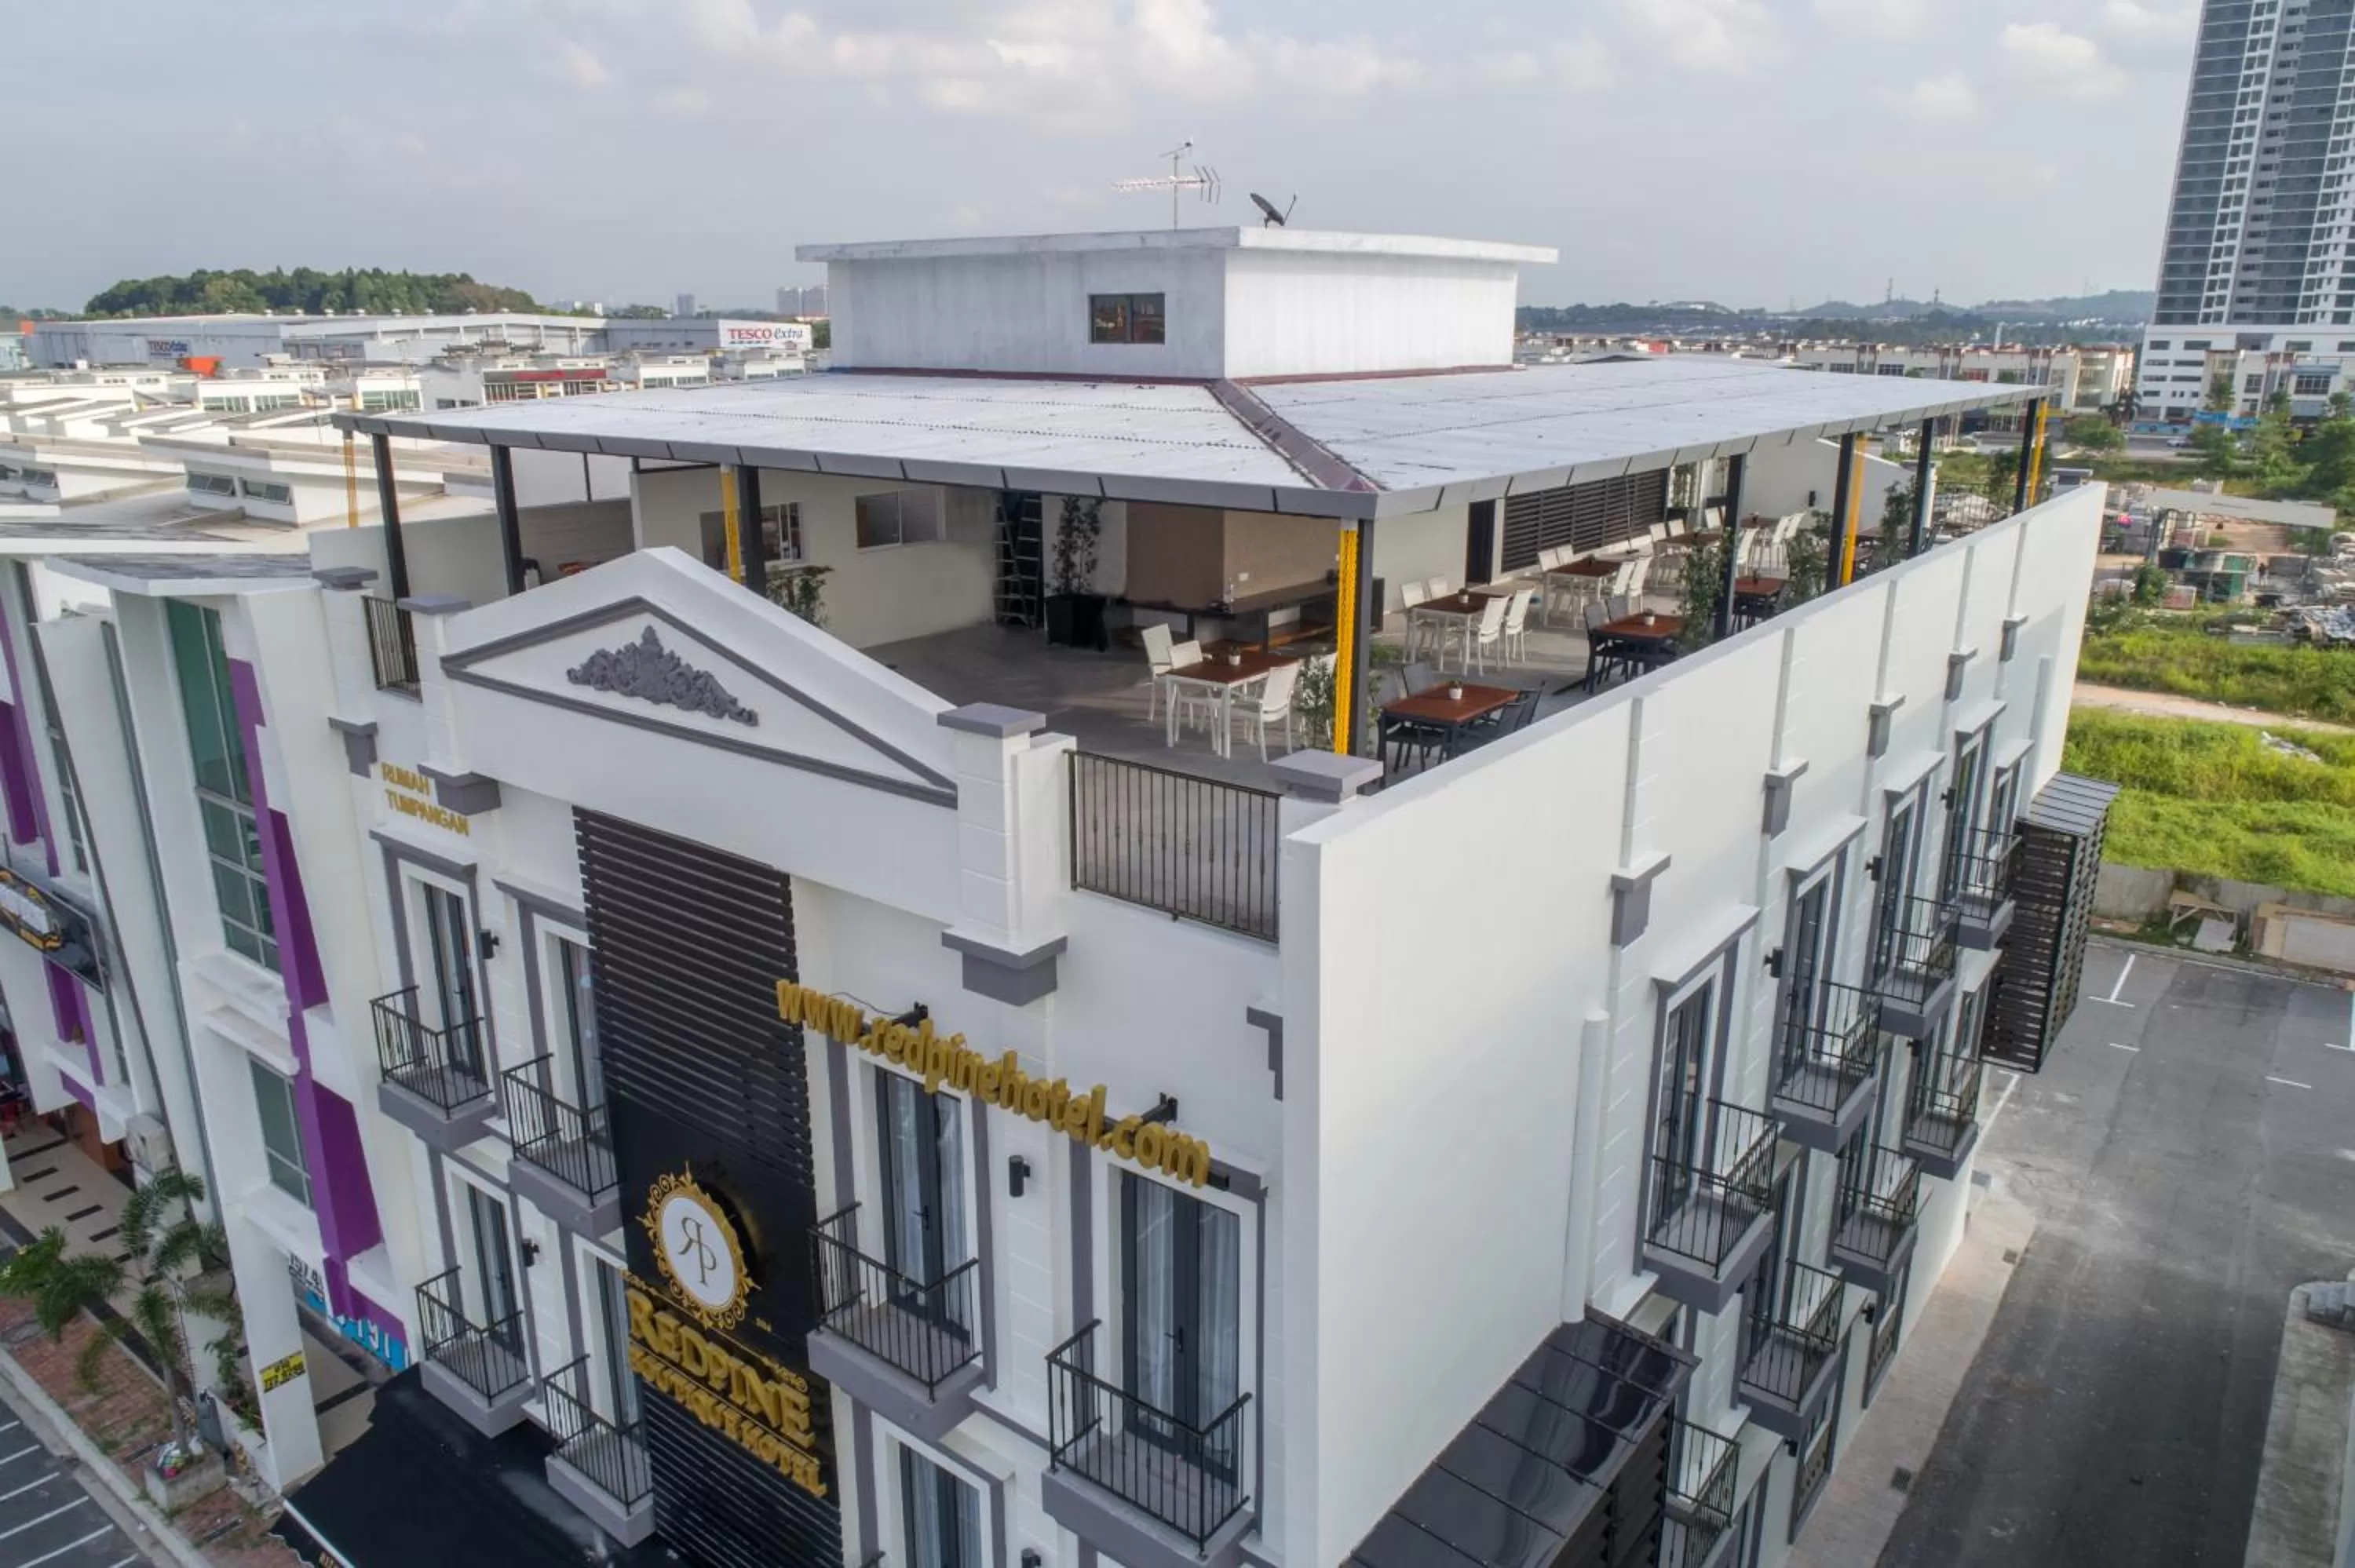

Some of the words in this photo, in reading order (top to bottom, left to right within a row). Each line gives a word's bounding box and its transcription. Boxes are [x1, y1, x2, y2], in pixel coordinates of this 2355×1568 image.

[728, 328, 772, 340] TESCO
[381, 761, 431, 797] RUMAH
[385, 788, 469, 837] TUMPANGAN
[776, 979, 1210, 1188] www.redpinehotel.com
[626, 1287, 816, 1449] REDPINE
[740, 1420, 827, 1498] HOTEL
